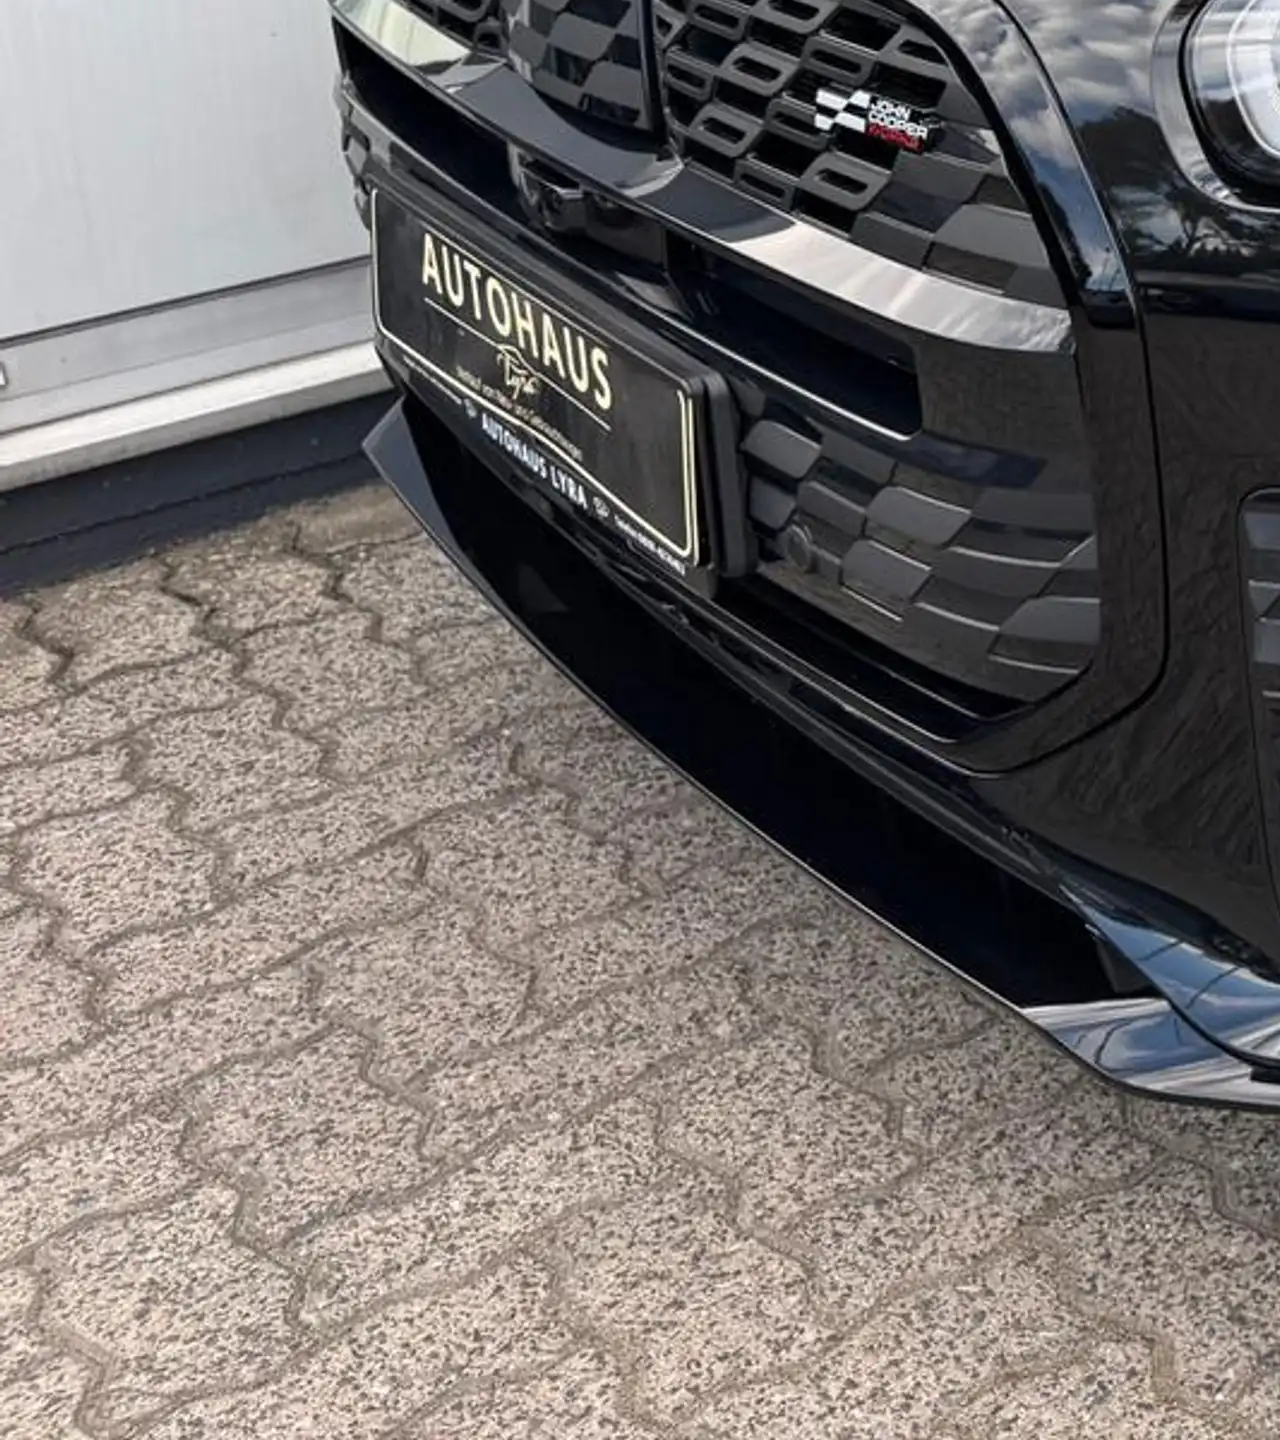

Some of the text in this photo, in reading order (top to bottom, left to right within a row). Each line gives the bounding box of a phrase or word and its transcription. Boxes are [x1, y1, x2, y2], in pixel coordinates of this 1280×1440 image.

[868, 110, 928, 140] COOPER
[869, 99, 911, 121] JOHN
[421, 232, 612, 410] AUTOHAUS
[481, 413, 547, 479] AUTOHAUS
[550, 464, 589, 510] LYRA
